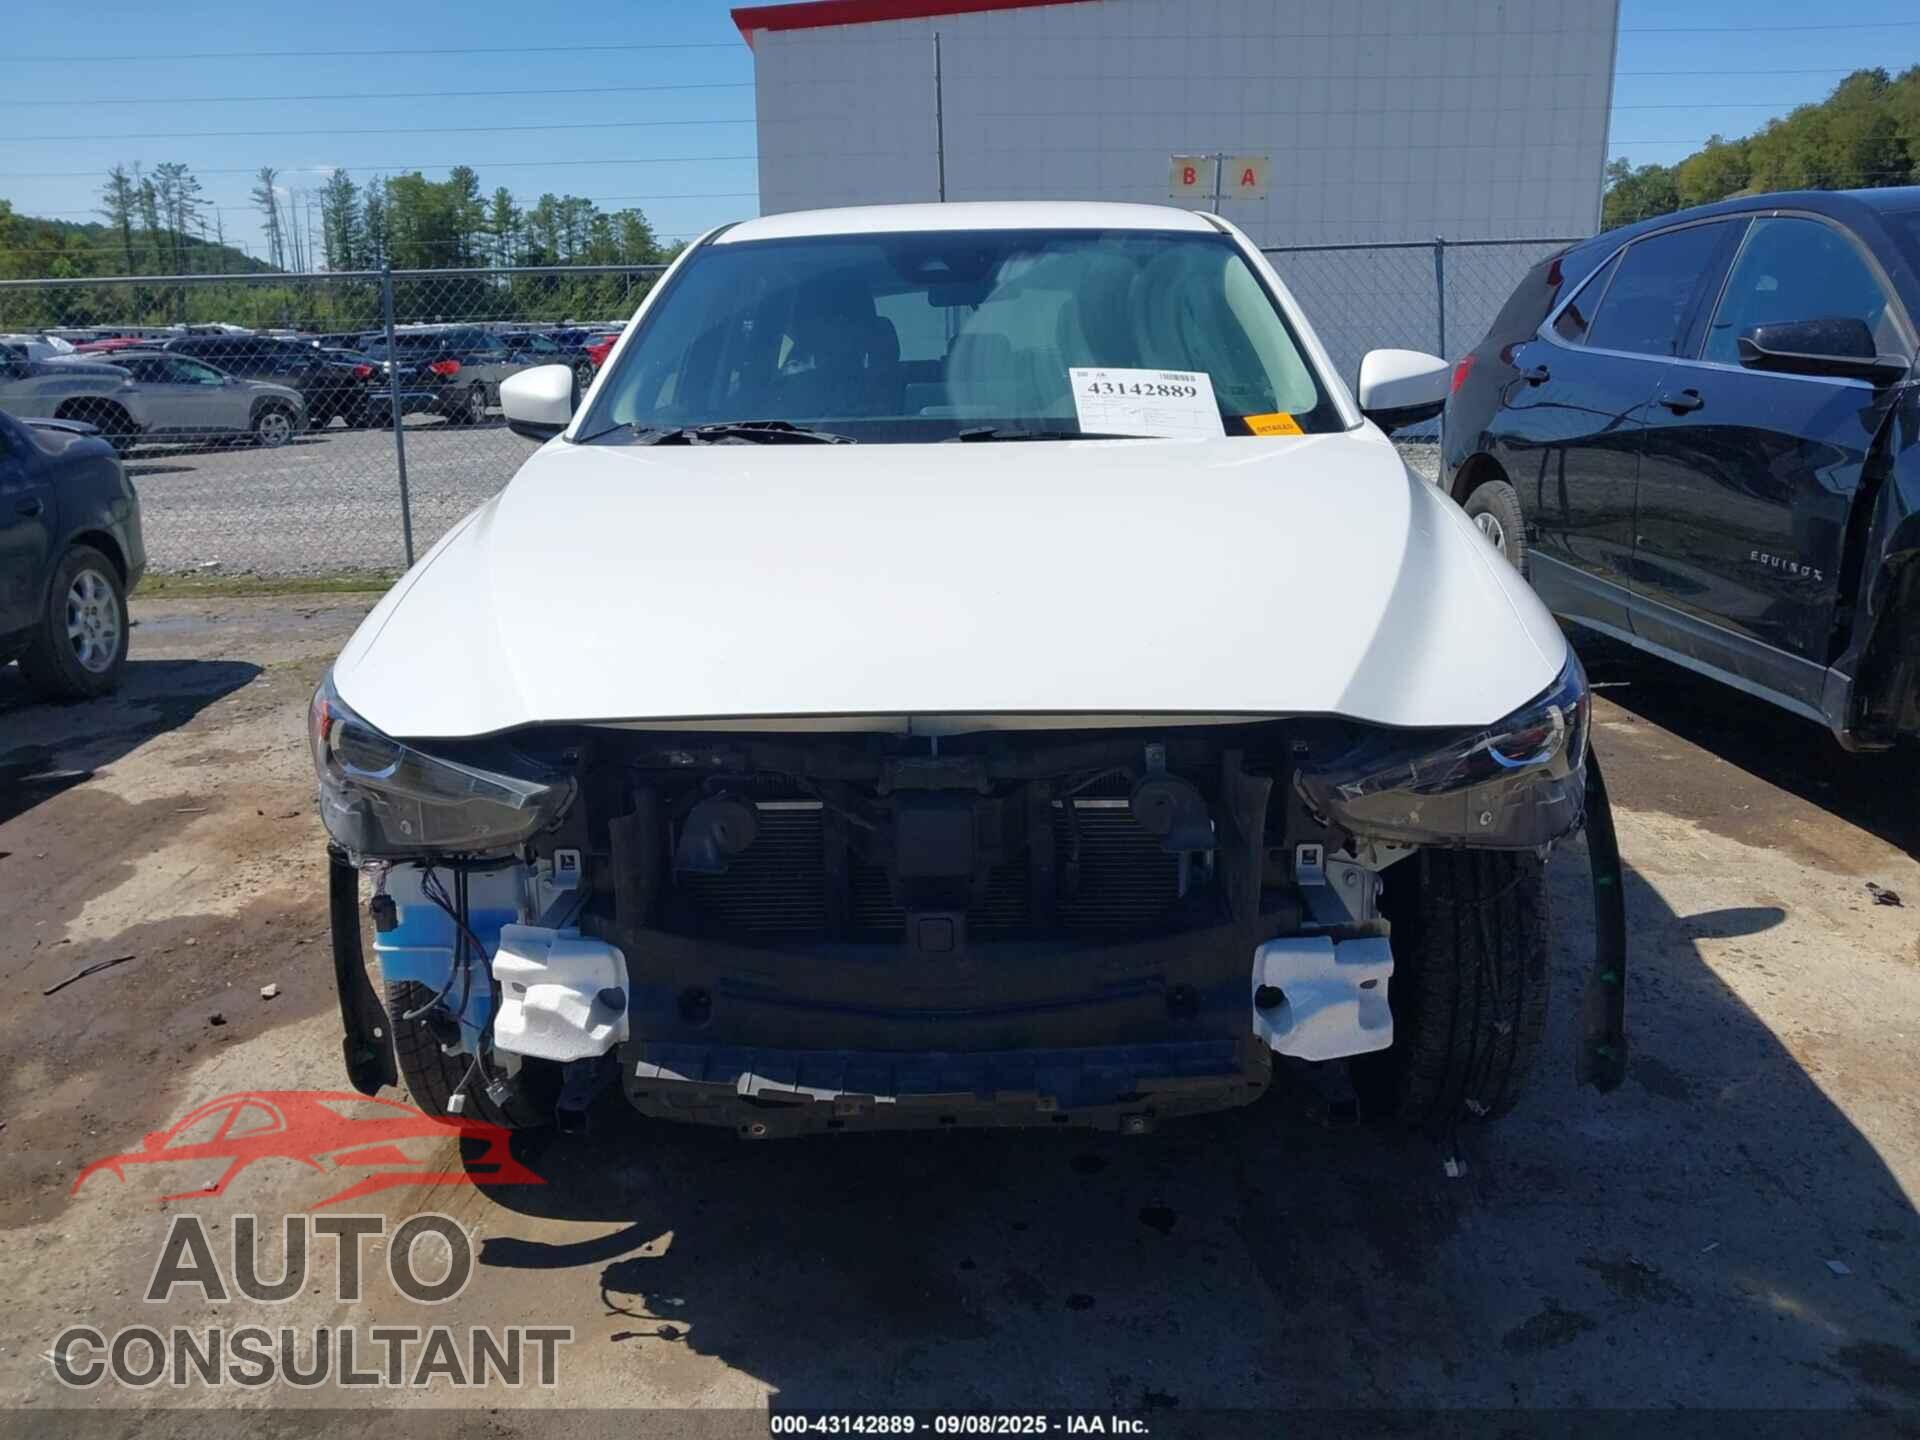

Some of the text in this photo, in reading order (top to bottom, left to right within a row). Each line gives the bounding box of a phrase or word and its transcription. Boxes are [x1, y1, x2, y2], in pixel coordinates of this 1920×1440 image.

[1183, 167, 1196, 185] B
[1241, 168, 1255, 186] A
[1087, 382, 1197, 398] 43142889
[1750, 550, 1823, 581] EQUINOX
